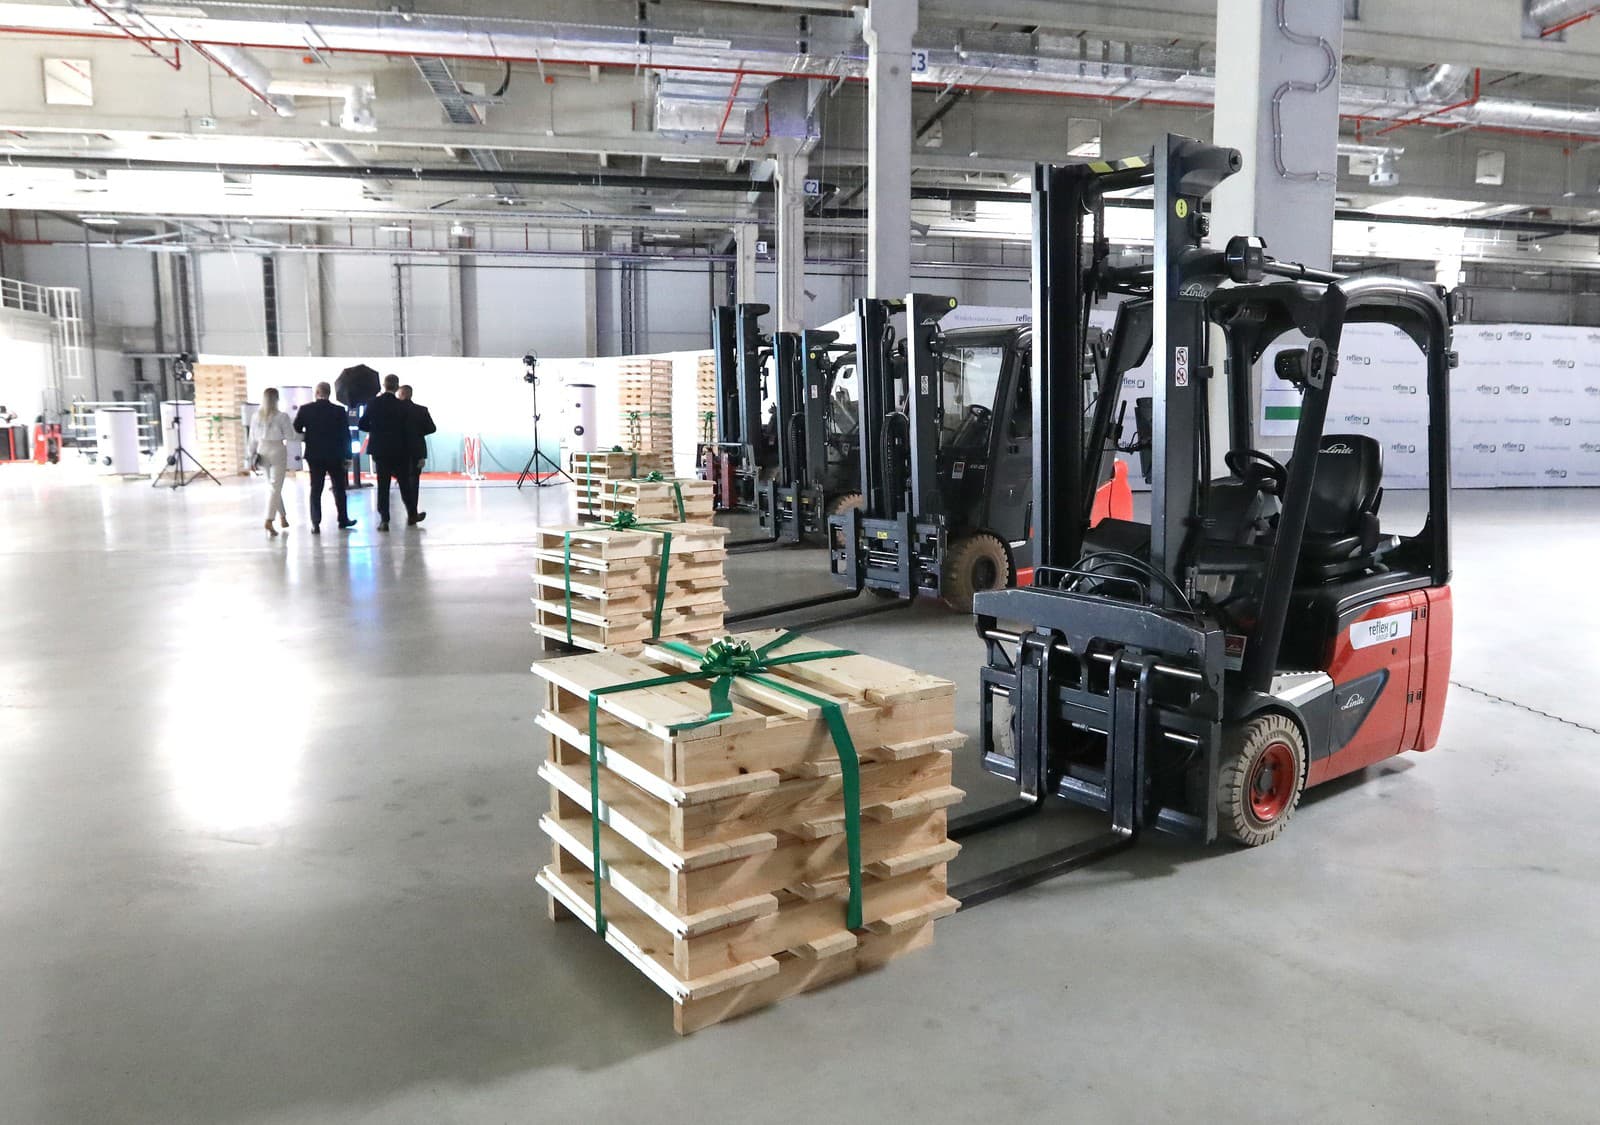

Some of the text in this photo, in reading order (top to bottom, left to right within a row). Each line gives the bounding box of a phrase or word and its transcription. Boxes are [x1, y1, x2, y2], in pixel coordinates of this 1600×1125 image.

[911, 53, 926, 72] C3
[804, 181, 818, 194] C2
[756, 242, 766, 252] C1
[1179, 282, 1208, 298] Linde
[1016, 313, 1032, 323] refle
[1318, 443, 1354, 455] Linde
[1369, 620, 1389, 636] reflex
[1340, 693, 1366, 710] Linde
